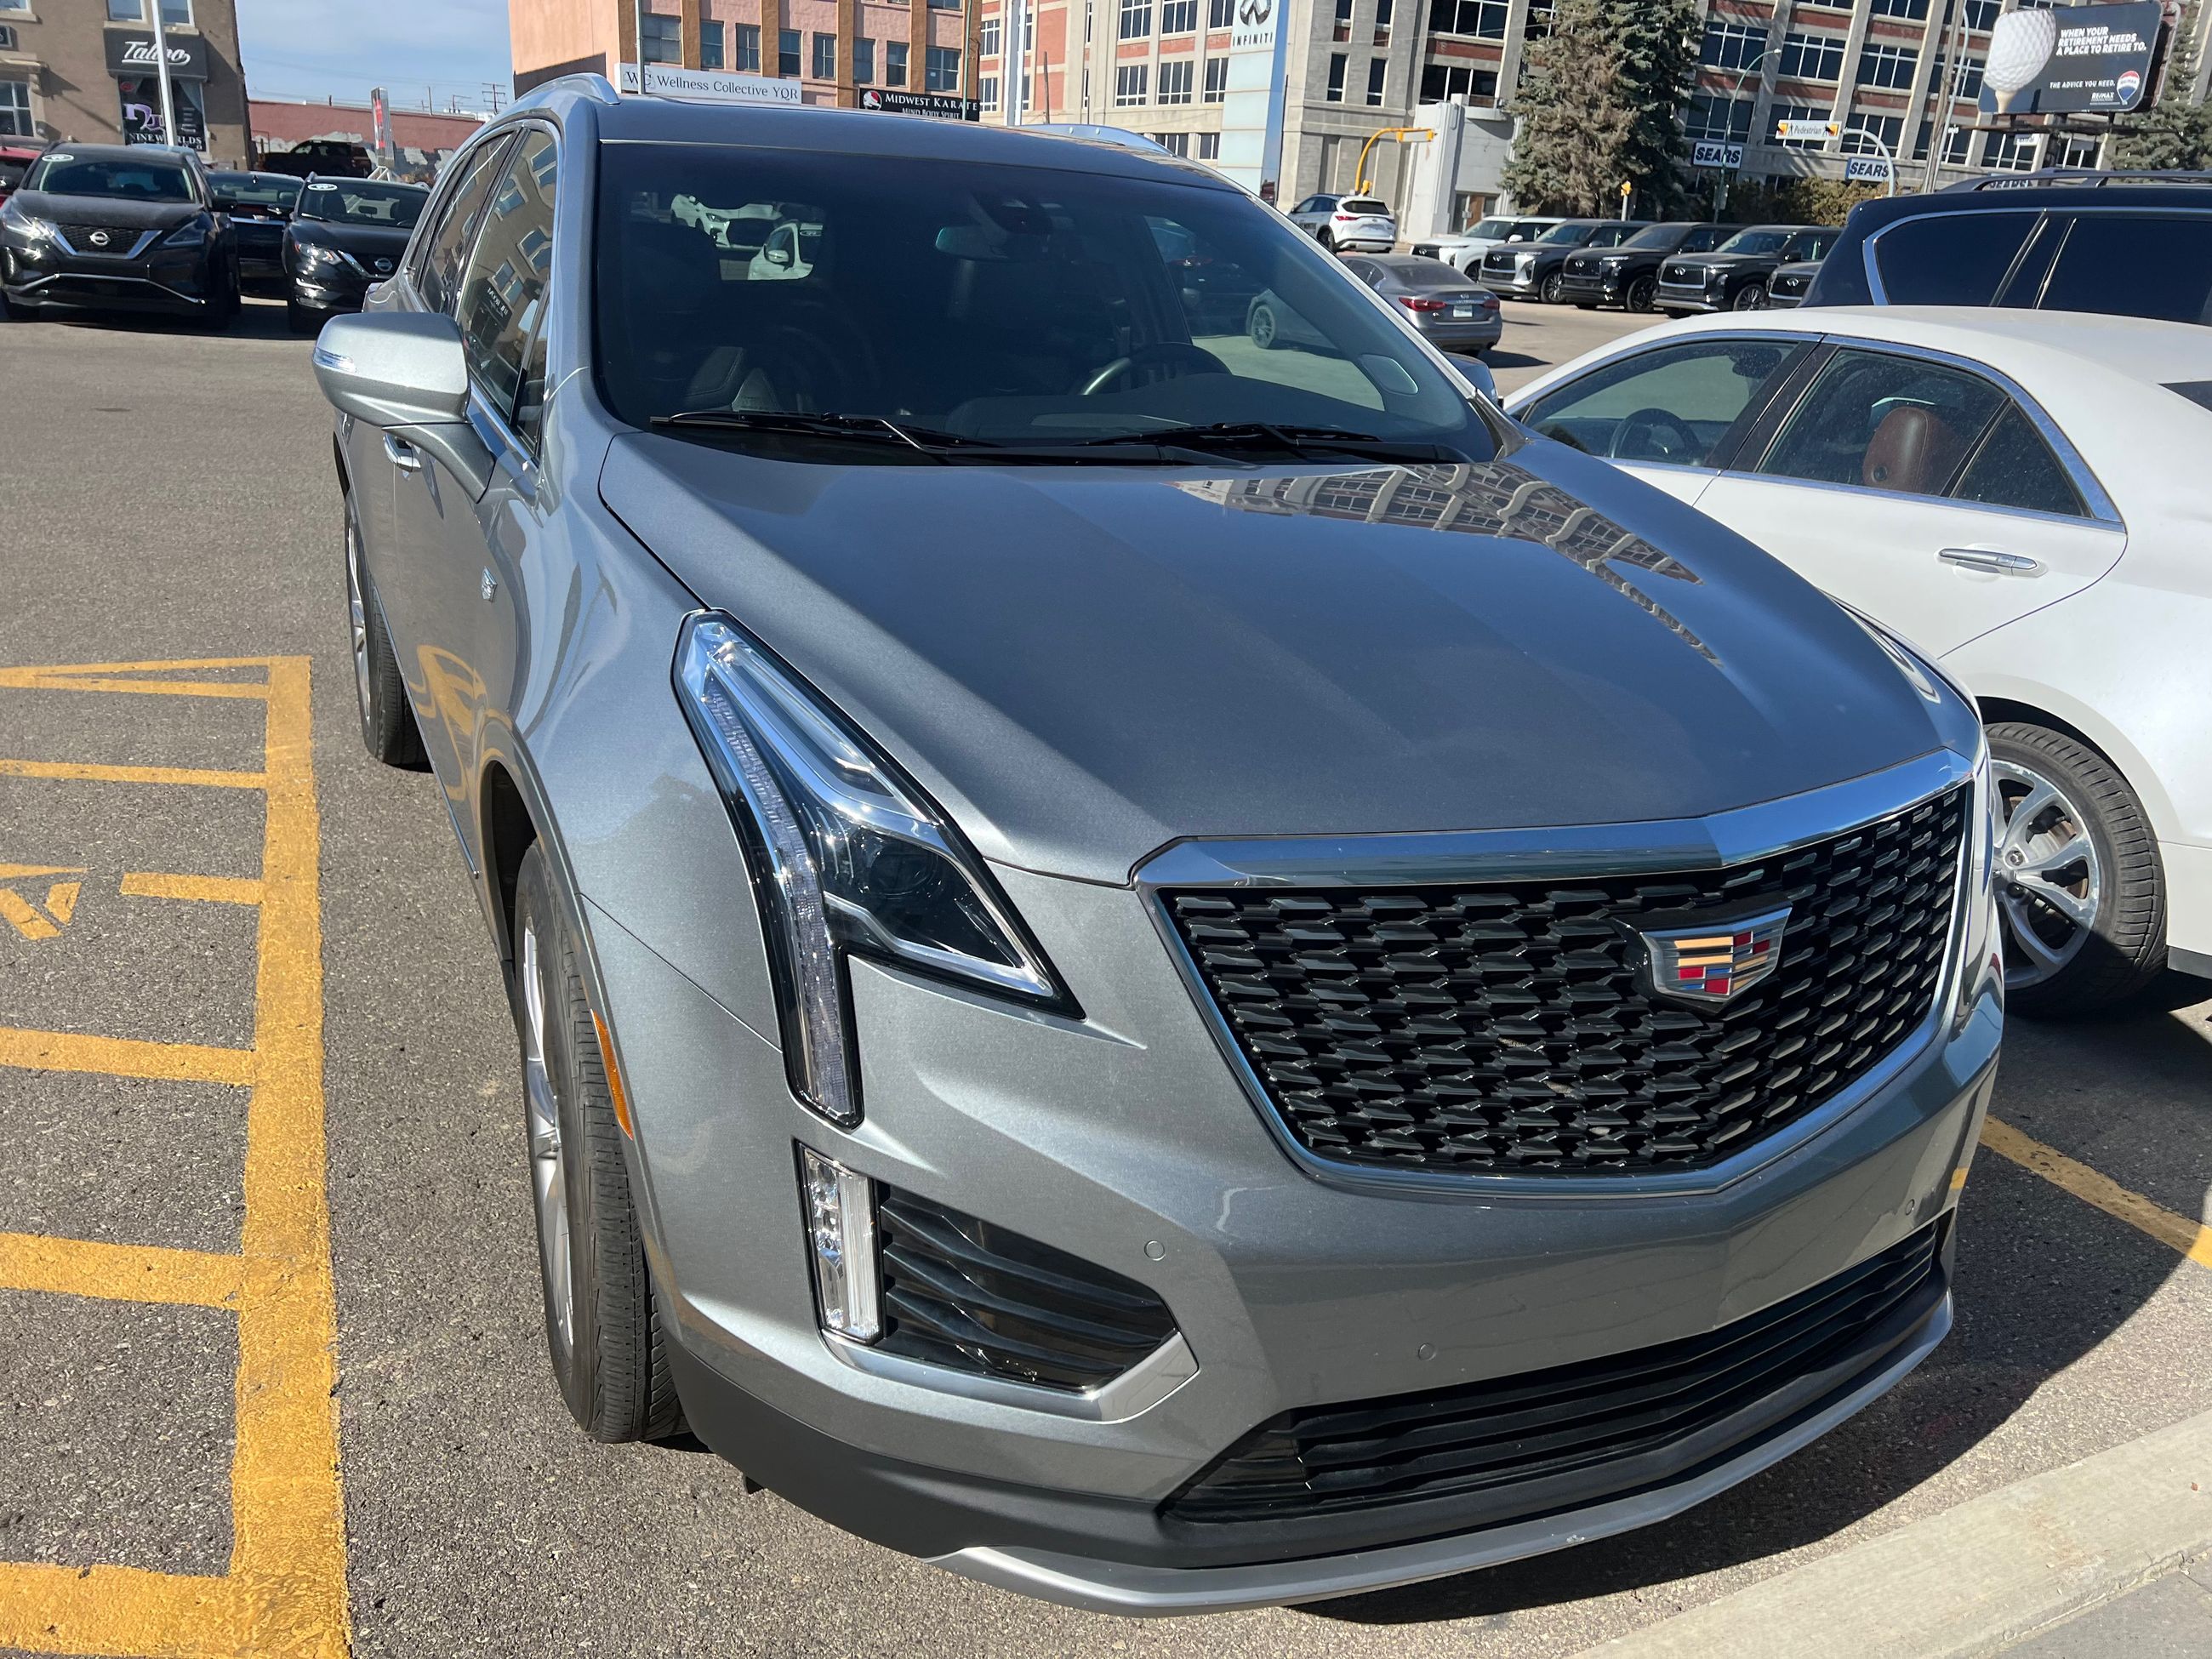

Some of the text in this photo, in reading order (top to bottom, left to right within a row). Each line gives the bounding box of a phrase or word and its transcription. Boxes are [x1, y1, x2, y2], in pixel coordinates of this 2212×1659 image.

[2061, 26, 2109, 38] WHEN YOUR
[1233, 32, 1273, 47] INFINITI
[2058, 33, 2137, 47] RETIREMENT NEEDS
[2055, 42, 2146, 55] A PLACE TO RETIRE TO.
[657, 75, 709, 90] Wellness
[713, 81, 768, 96] Collective
[772, 86, 798, 100] YQR
[885, 93, 978, 111] MIDWEST KARATE
[921, 109, 940, 117] BODY
[1793, 125, 1822, 134] Pedestrian
[155, 134, 202, 145] WRLDS
[1695, 146, 1741, 164] SEARS
[1849, 162, 1889, 177] SEARS
